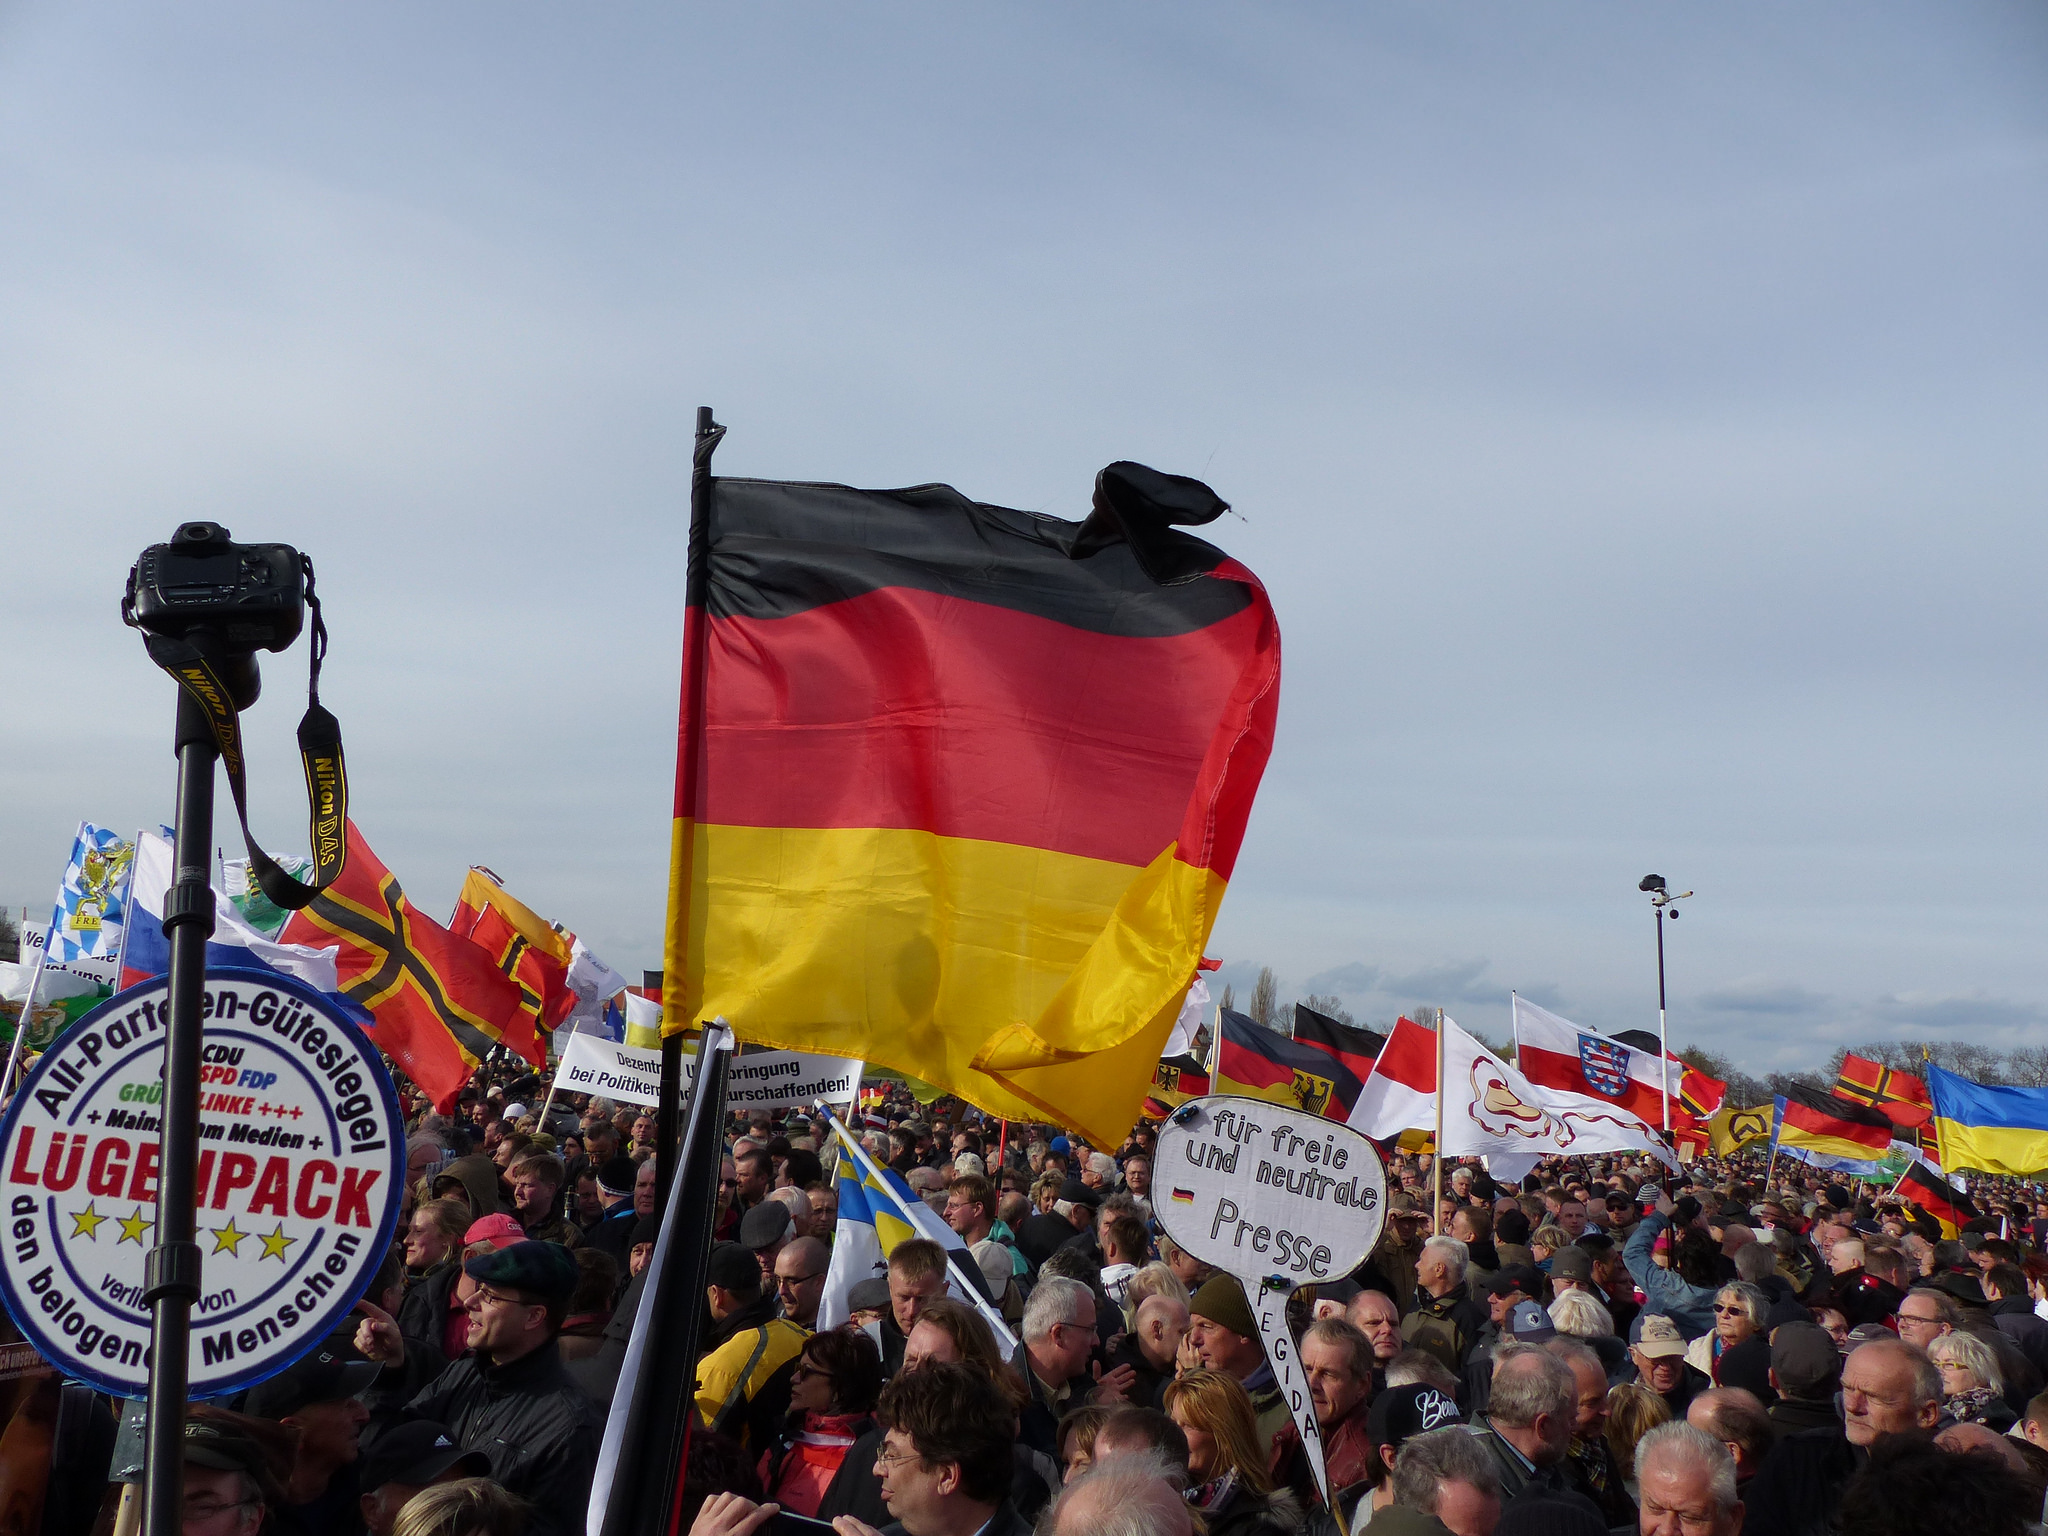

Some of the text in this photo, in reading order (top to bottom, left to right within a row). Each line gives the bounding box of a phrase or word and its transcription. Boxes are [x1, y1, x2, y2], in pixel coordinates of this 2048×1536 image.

[181, 668, 240, 775] Nikon D4s
[315, 757, 339, 867] Nikon D4s
[34, 990, 386, 1154] All-Parteen-Gütesiegel
[200, 1065, 277, 1090] SPD FDP
[202, 1043, 245, 1066] CDU
[569, 1065, 596, 1084] bei
[727, 1074, 850, 1102] urschaffenden!
[616, 1052, 800, 1081] Dezentr Ubringung
[105, 1108, 225, 1141] Mainsam
[227, 1122, 305, 1149] Medien
[119, 1080, 163, 1105] GRÜ
[200, 1091, 256, 1115] LINKE
[1213, 1110, 1349, 1170] für freie
[9, 1124, 382, 1230] LÜGEPACK
[1185, 1139, 1378, 1211] und neutrale
[1210, 1197, 1331, 1278] Presse
[11, 1194, 361, 1369] den belogen Menschen
[100, 1273, 237, 1314] verlie von
[1257, 1283, 1319, 1439] PEGIDA
